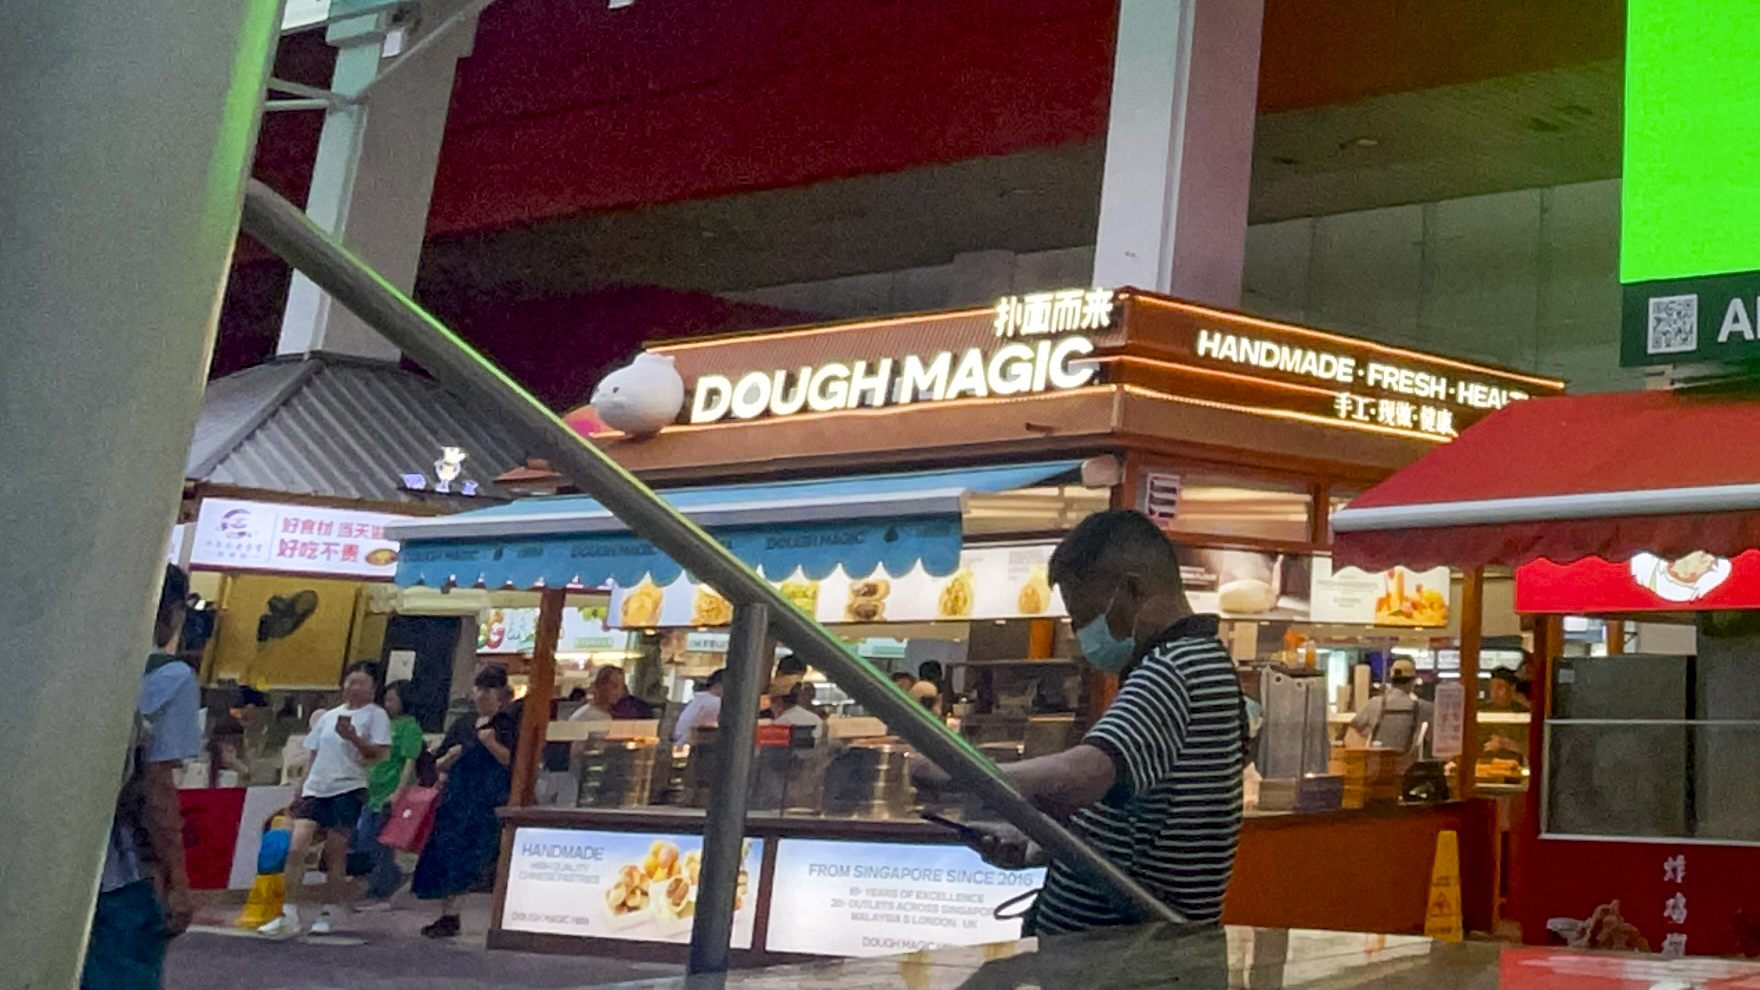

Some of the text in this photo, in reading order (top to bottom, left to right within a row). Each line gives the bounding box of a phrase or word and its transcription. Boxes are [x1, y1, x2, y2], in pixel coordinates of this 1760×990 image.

[691, 336, 1094, 424] DOUGH MAGIC
[1197, 330, 1530, 410] HANDMADE FRESH HEAL
[521, 842, 605, 861] HANDMADE
[809, 864, 1034, 887] FROM SINGAPORE SINCE 2016
[900, 890, 914, 899] OF
[915, 890, 985, 904] EXCELLENCE
[862, 936, 900, 948] DOUGH
